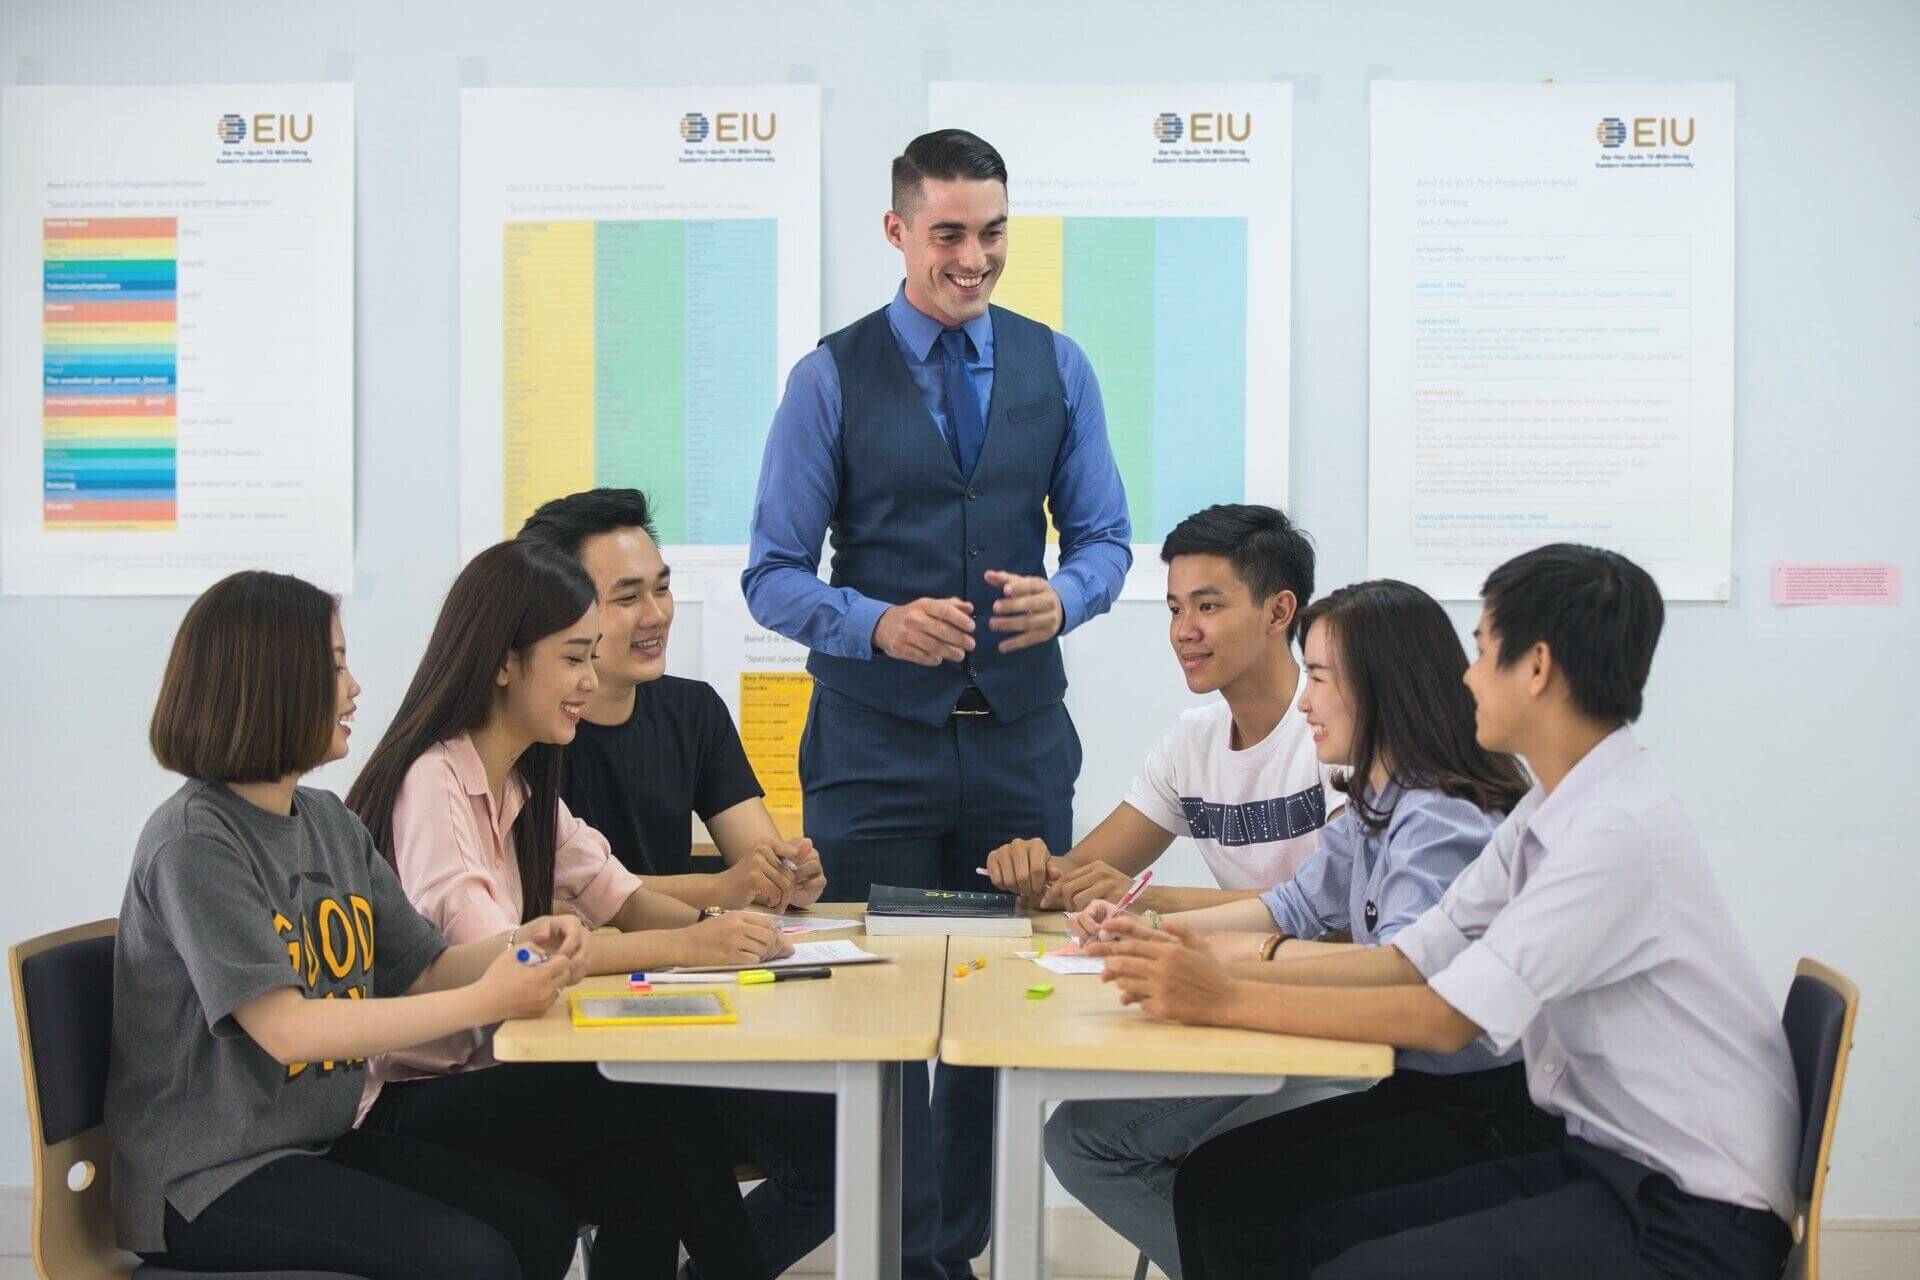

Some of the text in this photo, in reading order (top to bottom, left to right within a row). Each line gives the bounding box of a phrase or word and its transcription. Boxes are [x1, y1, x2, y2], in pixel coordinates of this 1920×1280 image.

[254, 114, 313, 143] EIU
[716, 113, 776, 142] EIU
[1191, 113, 1251, 142] EIU
[1634, 118, 1694, 147] EIU
[272, 894, 375, 989] GOOD
